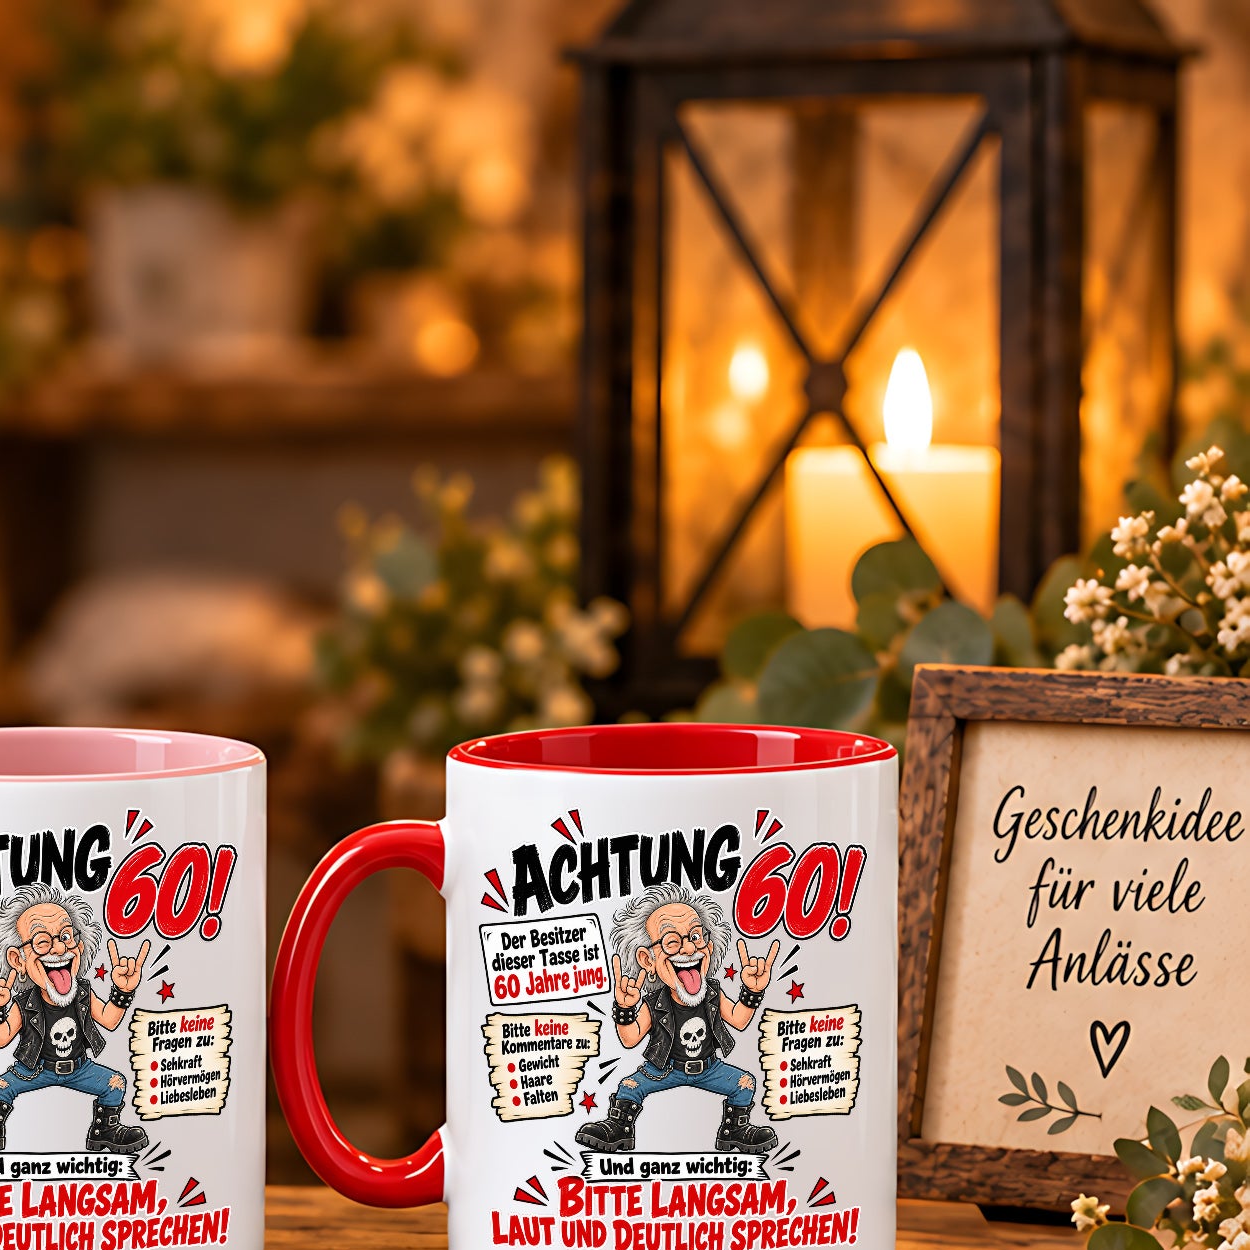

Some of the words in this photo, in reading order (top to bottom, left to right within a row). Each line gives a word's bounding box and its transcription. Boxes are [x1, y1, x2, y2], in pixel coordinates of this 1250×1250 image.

[993, 785, 1244, 863] Geschenkidee
[512, 825, 741, 916] ACHTUNG
[104, 842, 238, 941] 60!
[734, 842, 867, 941] 60!
[1026, 857, 1095, 928] für
[1112, 857, 1205, 913] viele
[501, 932, 526, 950] Der
[530, 926, 587, 948] Besitzer
[492, 954, 535, 971] dieser
[539, 950, 580, 967] Tasse
[583, 944, 599, 960] ist
[1026, 927, 1198, 991] Anlässe
[494, 974, 521, 999] 60
[525, 969, 570, 996] Jahre
[572, 965, 607, 993] jung.
[777, 1020, 806, 1037] Bitte
[809, 1014, 844, 1033] keine
[782, 1037, 821, 1053] Fragen
[825, 1035, 844, 1048] zu:
[790, 1055, 832, 1072] Sehkraft
[790, 1070, 850, 1088] Hörvermögen
[790, 1086, 846, 1105] Liebesleben
[10, 1161, 51, 1178] ganz
[56, 1157, 123, 1177] wichtig:
[600, 1157, 633, 1175] Und
[640, 1161, 680, 1178] ganz
[686, 1157, 753, 1177] wichtig:
[22, 1180, 167, 1218] LANGSAM,
[557, 1175, 643, 1217] BITTE
[651, 1180, 797, 1218] LANGSAM,
[491, 1211, 555, 1246] LAUT
[561, 1220, 607, 1248] UND
